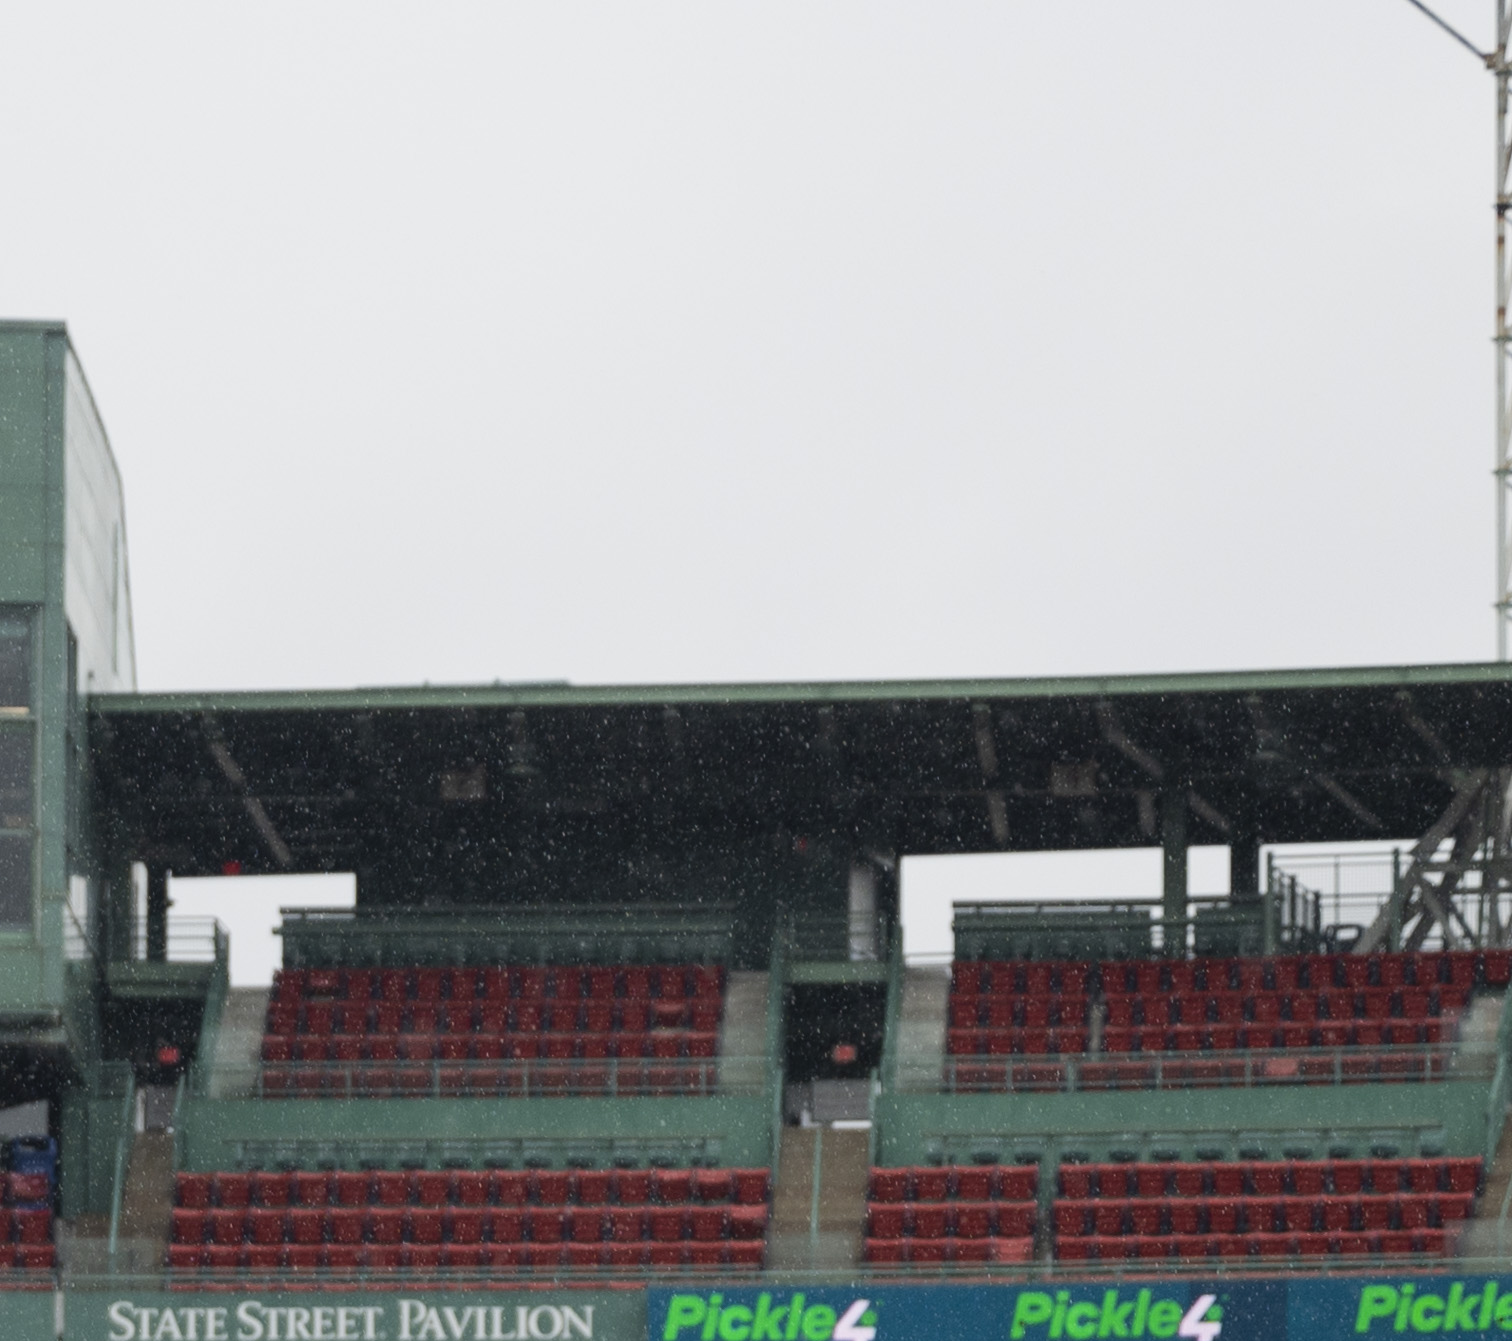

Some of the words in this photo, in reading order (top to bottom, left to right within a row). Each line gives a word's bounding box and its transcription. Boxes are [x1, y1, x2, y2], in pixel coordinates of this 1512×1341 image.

[108, 1299, 228, 1341] STATE
[237, 1300, 381, 1341] STREET
[398, 1298, 595, 1341] PAVILION
